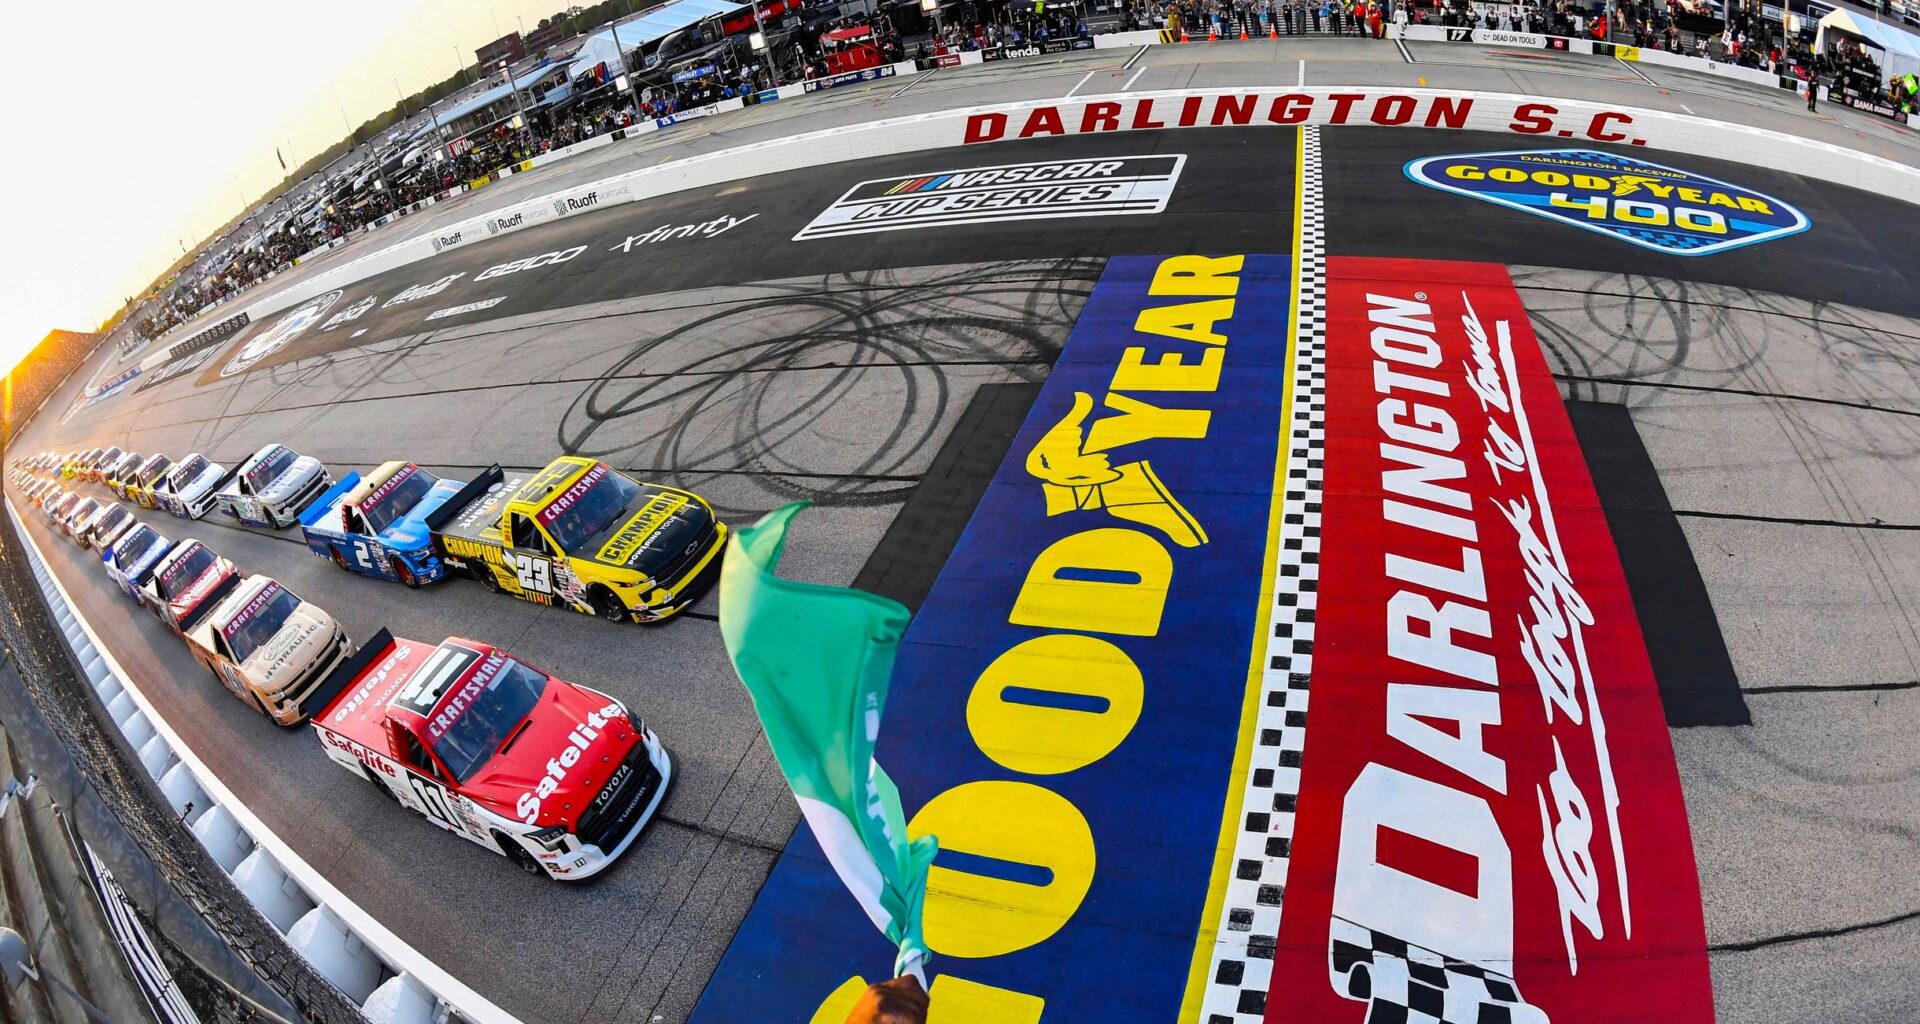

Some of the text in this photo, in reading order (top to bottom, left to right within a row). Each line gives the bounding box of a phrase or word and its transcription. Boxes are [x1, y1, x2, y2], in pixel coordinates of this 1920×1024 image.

[1005, 45, 1040, 59] tenda
[1450, 30, 1466, 41] 17
[1492, 34, 1536, 45] DEAD ON TOOLS
[963, 93, 1647, 146] DARLINGTON S.C.
[1853, 99, 1874, 112] BAMA
[939, 160, 1125, 190] NASCAR
[1520, 154, 1688, 180] DARLINGTON RACEWAY
[567, 186, 630, 212] Ruoff MORTGAGE
[851, 184, 1122, 220] CUP SERIES
[1445, 164, 1775, 215] GOODYEAR
[498, 213, 524, 231] Ruoff
[1549, 191, 1728, 234] 400
[441, 232, 462, 248] Ruoff
[609, 212, 760, 252] xfinity
[473, 245, 588, 282] GEICO
[250, 446, 286, 477] CRAFTSMAN
[363, 465, 411, 509] CRAFTSMAN
[544, 466, 607, 520] CRAFTSMAN
[119, 528, 147, 555] CRAFTSMAN
[354, 541, 373, 569] 2
[443, 537, 504, 565] CHAMPION
[627, 530, 662, 566] POWERING
[163, 543, 200, 580] CRAFTSMAN
[430, 570, 438, 578] 2
[517, 554, 552, 594] 23
[227, 584, 277, 635] CRAFTSMAN
[810, 253, 1244, 1024] OODYEAR
[1328, 292, 1535, 1024] DARLINGTON
[334, 645, 412, 722] Safelite
[373, 673, 409, 707] TOYOTA
[428, 655, 504, 737] CRAFTSMAN
[325, 730, 397, 778] Safelite
[516, 703, 622, 826] Safelite
[409, 777, 461, 829] 11
[595, 764, 630, 806] TOYOTA
[617, 786, 647, 823] TUNDRA
[575, 857, 587, 868] 11
